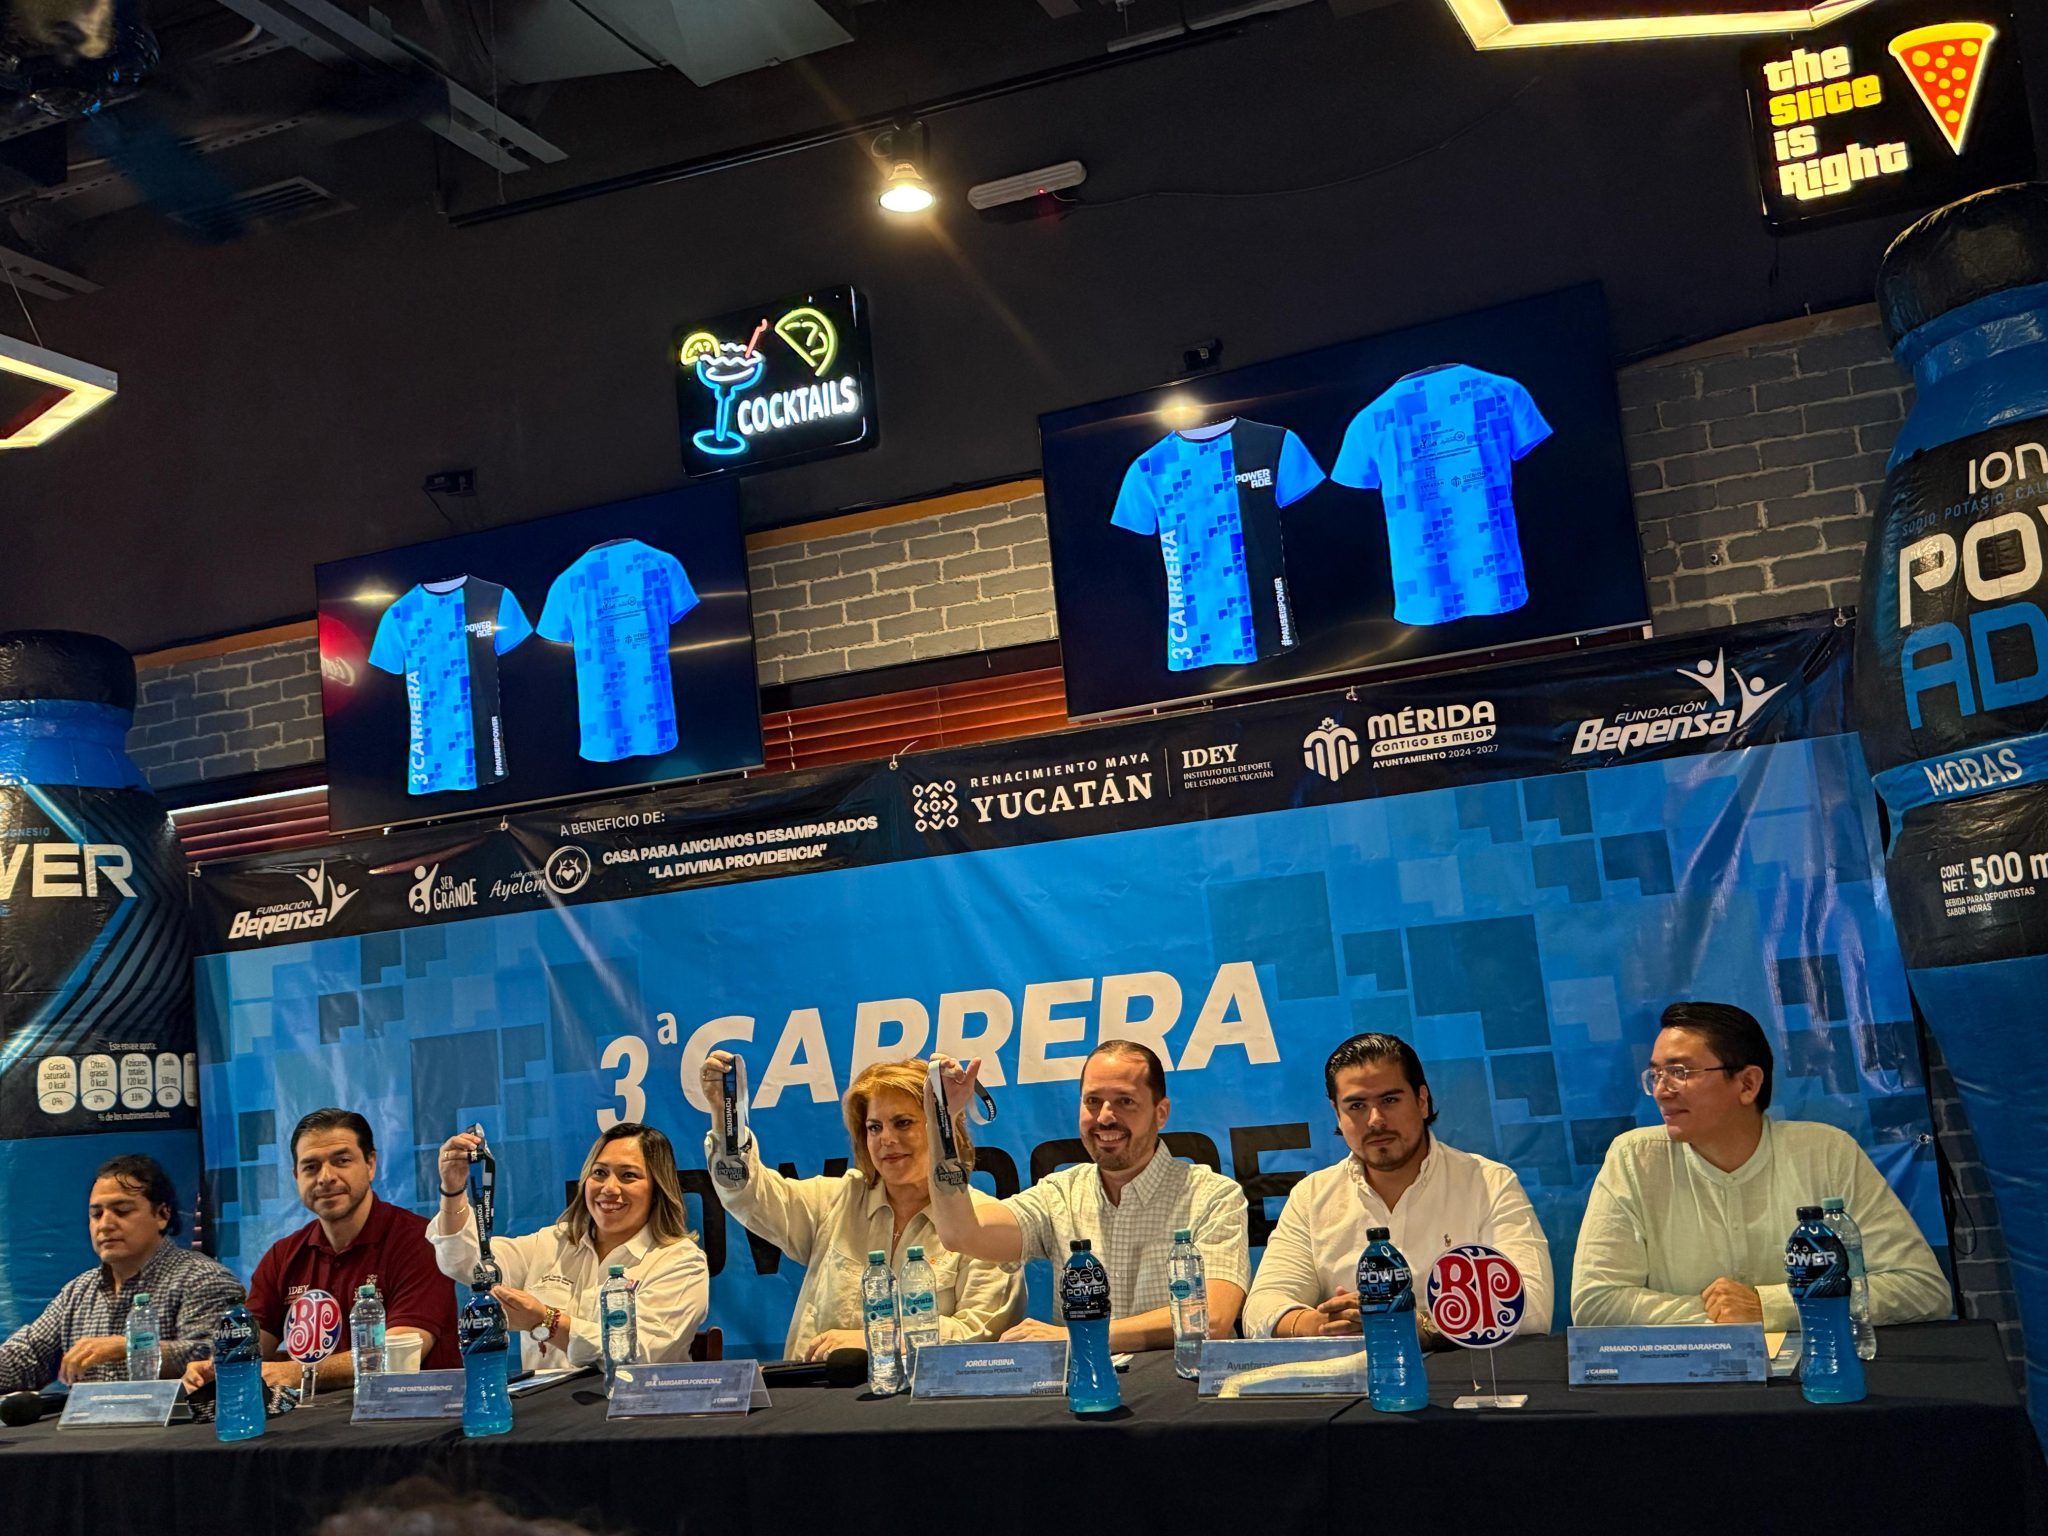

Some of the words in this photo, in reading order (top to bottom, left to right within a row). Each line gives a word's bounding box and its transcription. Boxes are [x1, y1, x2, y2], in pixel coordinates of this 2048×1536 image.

[1764, 46, 1850, 91] the
[1769, 75, 1882, 126] slice
[1773, 125, 1818, 161] is
[1778, 141, 1909, 200] Right
[737, 376, 859, 435] COCKTAILS
[1235, 468, 1270, 485] POWER
[1902, 512, 1936, 537] SODIO
[1945, 492, 2004, 520] POTASIO
[1900, 503, 2048, 628] PO
[1160, 529, 1188, 643] CARRERA
[406, 670, 425, 769] CARRERA
[1367, 700, 1495, 740] MÉRIDA
[1615, 700, 1707, 724] FUNDACIÓN
[1434, 734, 1448, 744] ES
[1452, 728, 1493, 742] MEJOR
[1571, 709, 1736, 756] Bepensa
[1181, 743, 1239, 769] IDEY
[1373, 751, 1447, 769] AYUNTAMIENTO
[1448, 743, 1499, 759] 2024-2027
[970, 760, 1098, 788] RENACIMIENTO
[1106, 752, 1150, 767] MAYA
[1183, 767, 1221, 780] INSTITUTO
[1222, 766, 1237, 776] DEL
[1238, 761, 1272, 774] DEPORTE
[1184, 779, 1199, 789] DEL
[1199, 776, 1228, 788] ESTADO
[1229, 775, 1239, 785] DE
[1923, 748, 2022, 796] MORAS
[970, 773, 1153, 824] YUCATÁN
[560, 825, 569, 837] A
[571, 814, 639, 836] BENEFICIO
[642, 811, 665, 825] DE:
[602, 847, 639, 865] CASA
[640, 843, 678, 861] PARA
[680, 833, 754, 855] ANCIANOS
[755, 816, 878, 844] DESAMPARADOS
[675, 858, 724, 877] DIVINA
[1940, 863, 1967, 879] CONT.
[1970, 851, 2023, 889] 500
[433, 877, 478, 910] GRANDE
[440, 875, 454, 891] SER
[1942, 878, 1968, 893] NET.
[256, 900, 312, 915] FUNDACIÓN
[1944, 896, 1966, 908] BEBIDA
[1966, 894, 1984, 905] PARA
[1984, 886, 2036, 902] DEPORTISTAS
[1946, 906, 1967, 917] SABOR
[1967, 903, 1992, 914] MORAS
[228, 908, 329, 940] Bepensa
[1784, 1251, 1838, 1267] OWER
[1359, 1267, 1412, 1284] POWER
[288, 1284, 310, 1296] IDEY
[1066, 1285, 1106, 1297] POWER
[1434, 1253, 1522, 1335] BP
[213, 1327, 252, 1340] OWER
[457, 1317, 494, 1329] OWER
[1599, 1345, 1638, 1353] ARMANDO
[965, 1359, 987, 1367] JORGE
[988, 1358, 1015, 1366] URBINA
